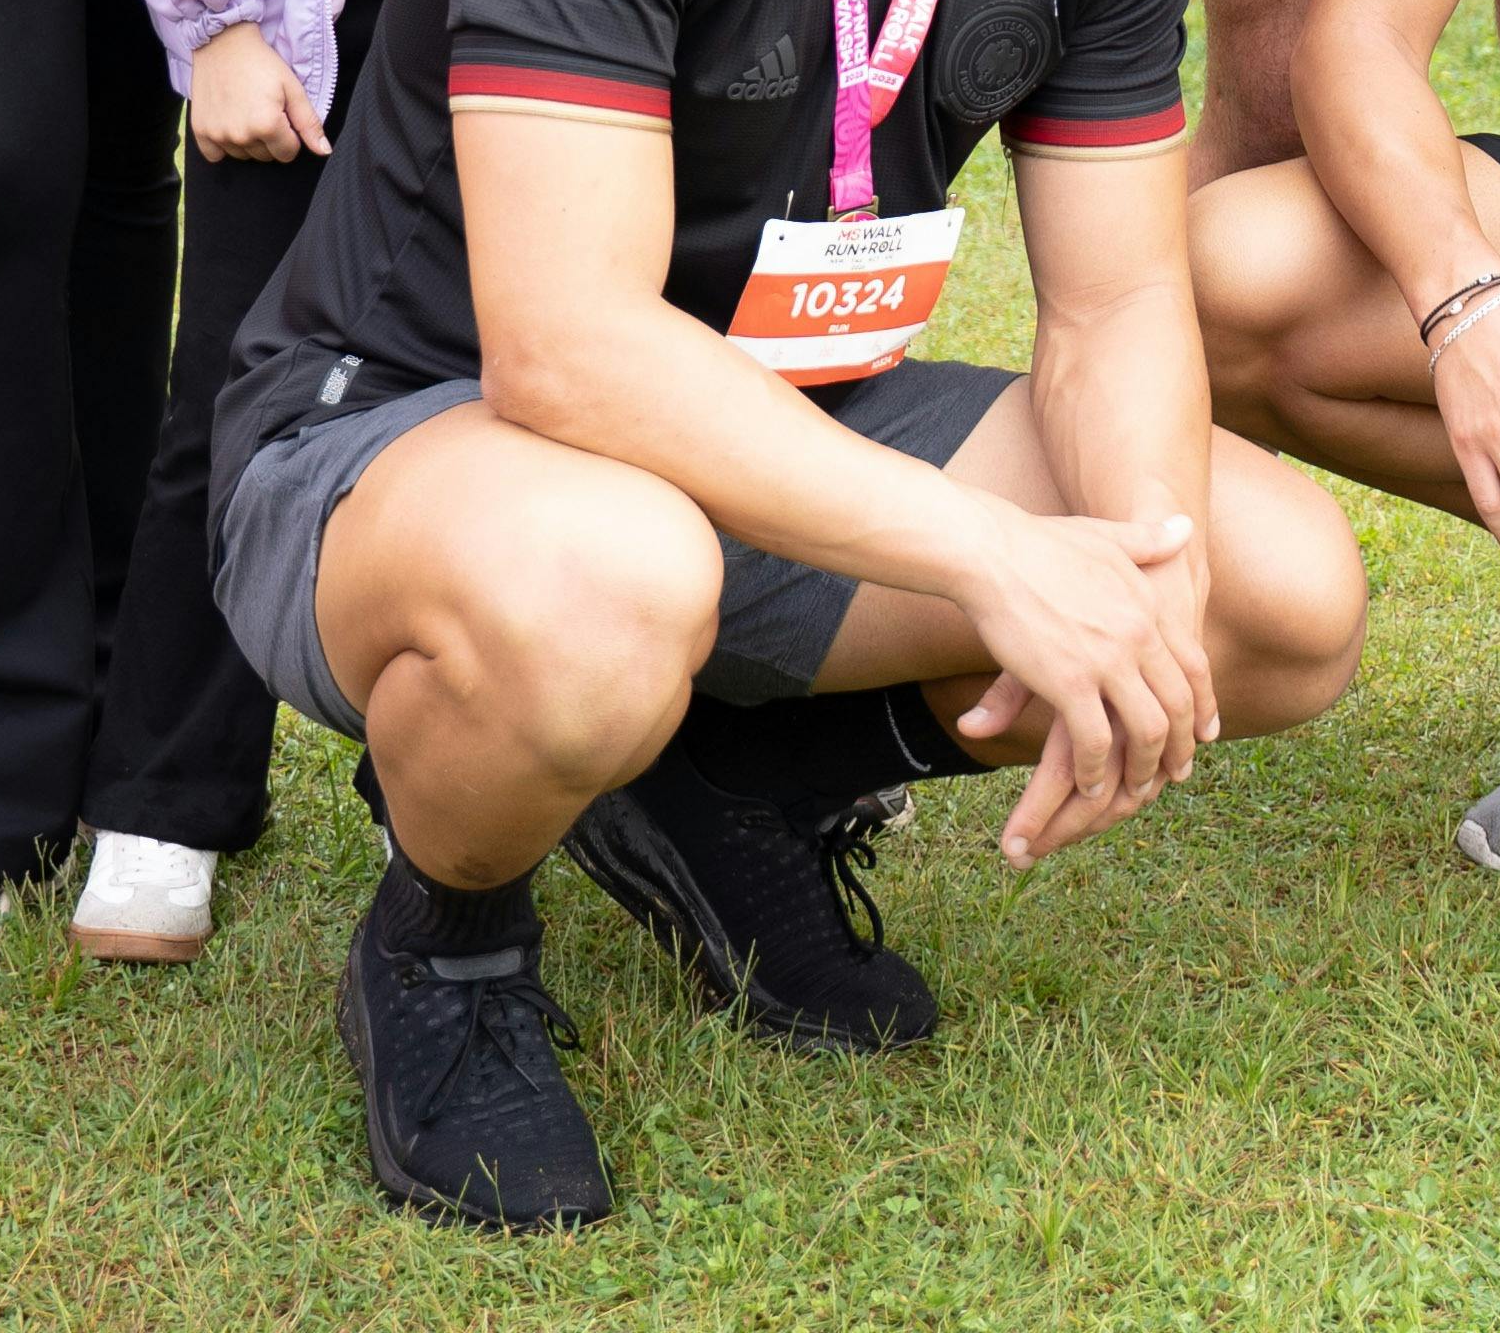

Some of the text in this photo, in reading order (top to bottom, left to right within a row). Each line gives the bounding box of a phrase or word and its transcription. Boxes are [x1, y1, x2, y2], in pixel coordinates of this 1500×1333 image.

[838, 35, 855, 73] MS
[726, 75, 800, 101] adidas
[838, 224, 904, 241] MS WALK
[825, 240, 902, 257] RUN+ROLL
[790, 274, 906, 318] 10324
[828, 323, 850, 334] RUN
